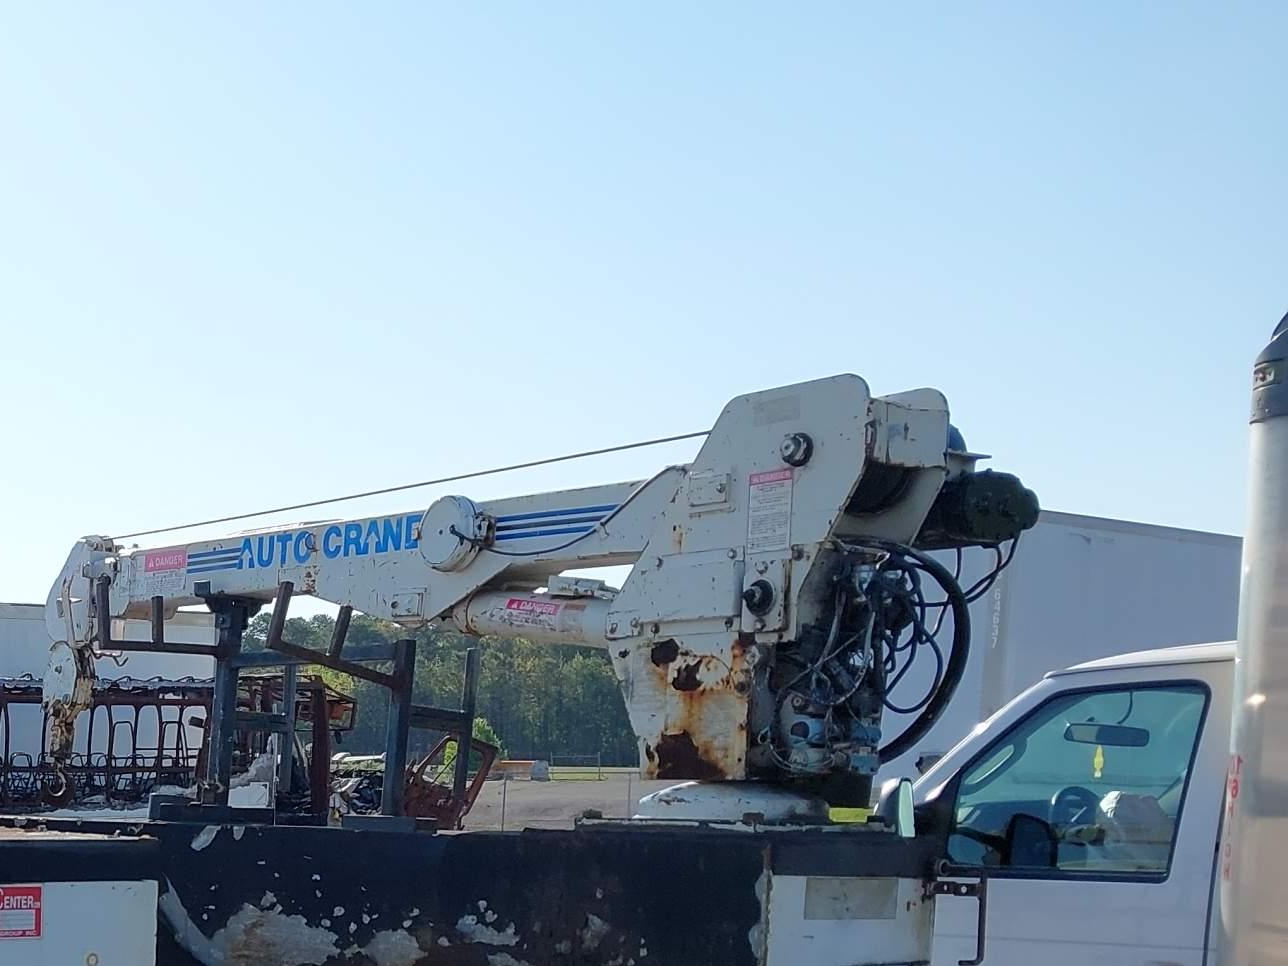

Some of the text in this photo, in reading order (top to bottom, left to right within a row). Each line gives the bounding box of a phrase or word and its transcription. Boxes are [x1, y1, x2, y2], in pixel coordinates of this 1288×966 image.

[237, 530, 316, 570] AUTO
[155, 554, 183, 567] DANGER
[520, 600, 556, 614] DANGER
